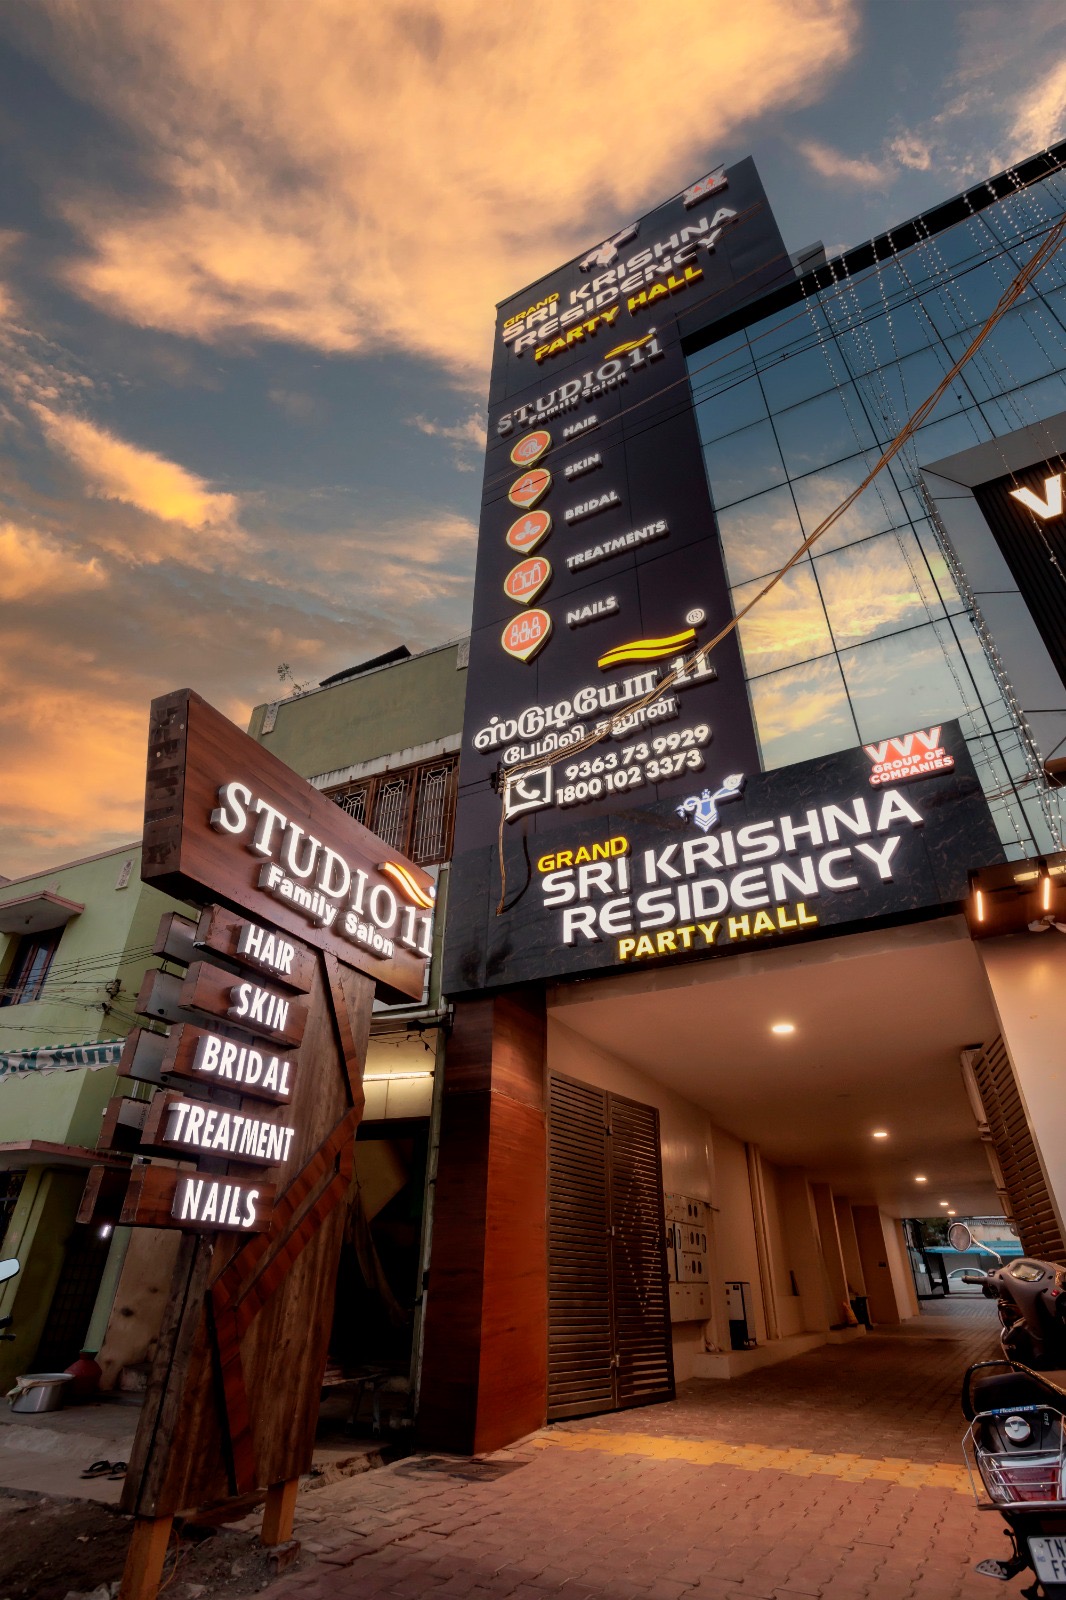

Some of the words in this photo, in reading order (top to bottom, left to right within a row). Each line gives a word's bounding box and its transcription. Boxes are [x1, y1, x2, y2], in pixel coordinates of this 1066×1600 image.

[502, 301, 558, 343] SRI
[570, 207, 738, 304] KRISHNA
[514, 228, 722, 354] RESIDENCY
[503, 292, 560, 327] GRAND
[534, 306, 619, 361] PARTY
[628, 267, 702, 312] HALL
[497, 359, 622, 433] STUDIO
[529, 393, 579, 424] Family
[562, 415, 598, 437] HAIR
[564, 453, 600, 477] SKIN
[564, 490, 619, 521] BRIDAL
[1009, 472, 1066, 520] V
[566, 520, 667, 568] TREATMENTS
[566, 596, 618, 624] NAILS
[474, 670, 658, 749] ஸ்டுடியோ
[669, 651, 713, 685] 11
[503, 723, 585, 764] பேமிலி
[565, 751, 618, 780] 9363
[622, 743, 649, 764] 73
[652, 725, 709, 754] 9929
[864, 726, 942, 763] VVV
[872, 755, 921, 773] GROUP
[924, 749, 945, 761] OF
[556, 777, 602, 805] 1800
[605, 766, 643, 789] 102
[646, 749, 702, 778] 3373
[870, 756, 954, 784] COMPANIES
[219, 782, 397, 930] STUDIO
[402, 906, 432, 958] 11
[537, 836, 629, 873] GRAND
[542, 857, 629, 907] SRI
[645, 789, 923, 884] KRISHNA
[268, 865, 338, 926] Family
[344, 913, 395, 957] Salon
[562, 836, 901, 945] RESIDENCY
[245, 923, 295, 975] HAIR
[618, 921, 719, 960] PARTY
[729, 903, 818, 940] HALL
[236, 983, 290, 1032] SKIN
[200, 1035, 290, 1096] BRIDAL
[171, 1102, 294, 1162] TREATMENT
[180, 1178, 259, 1228] NAILS
[1044, 1538, 1066, 1558] TN
